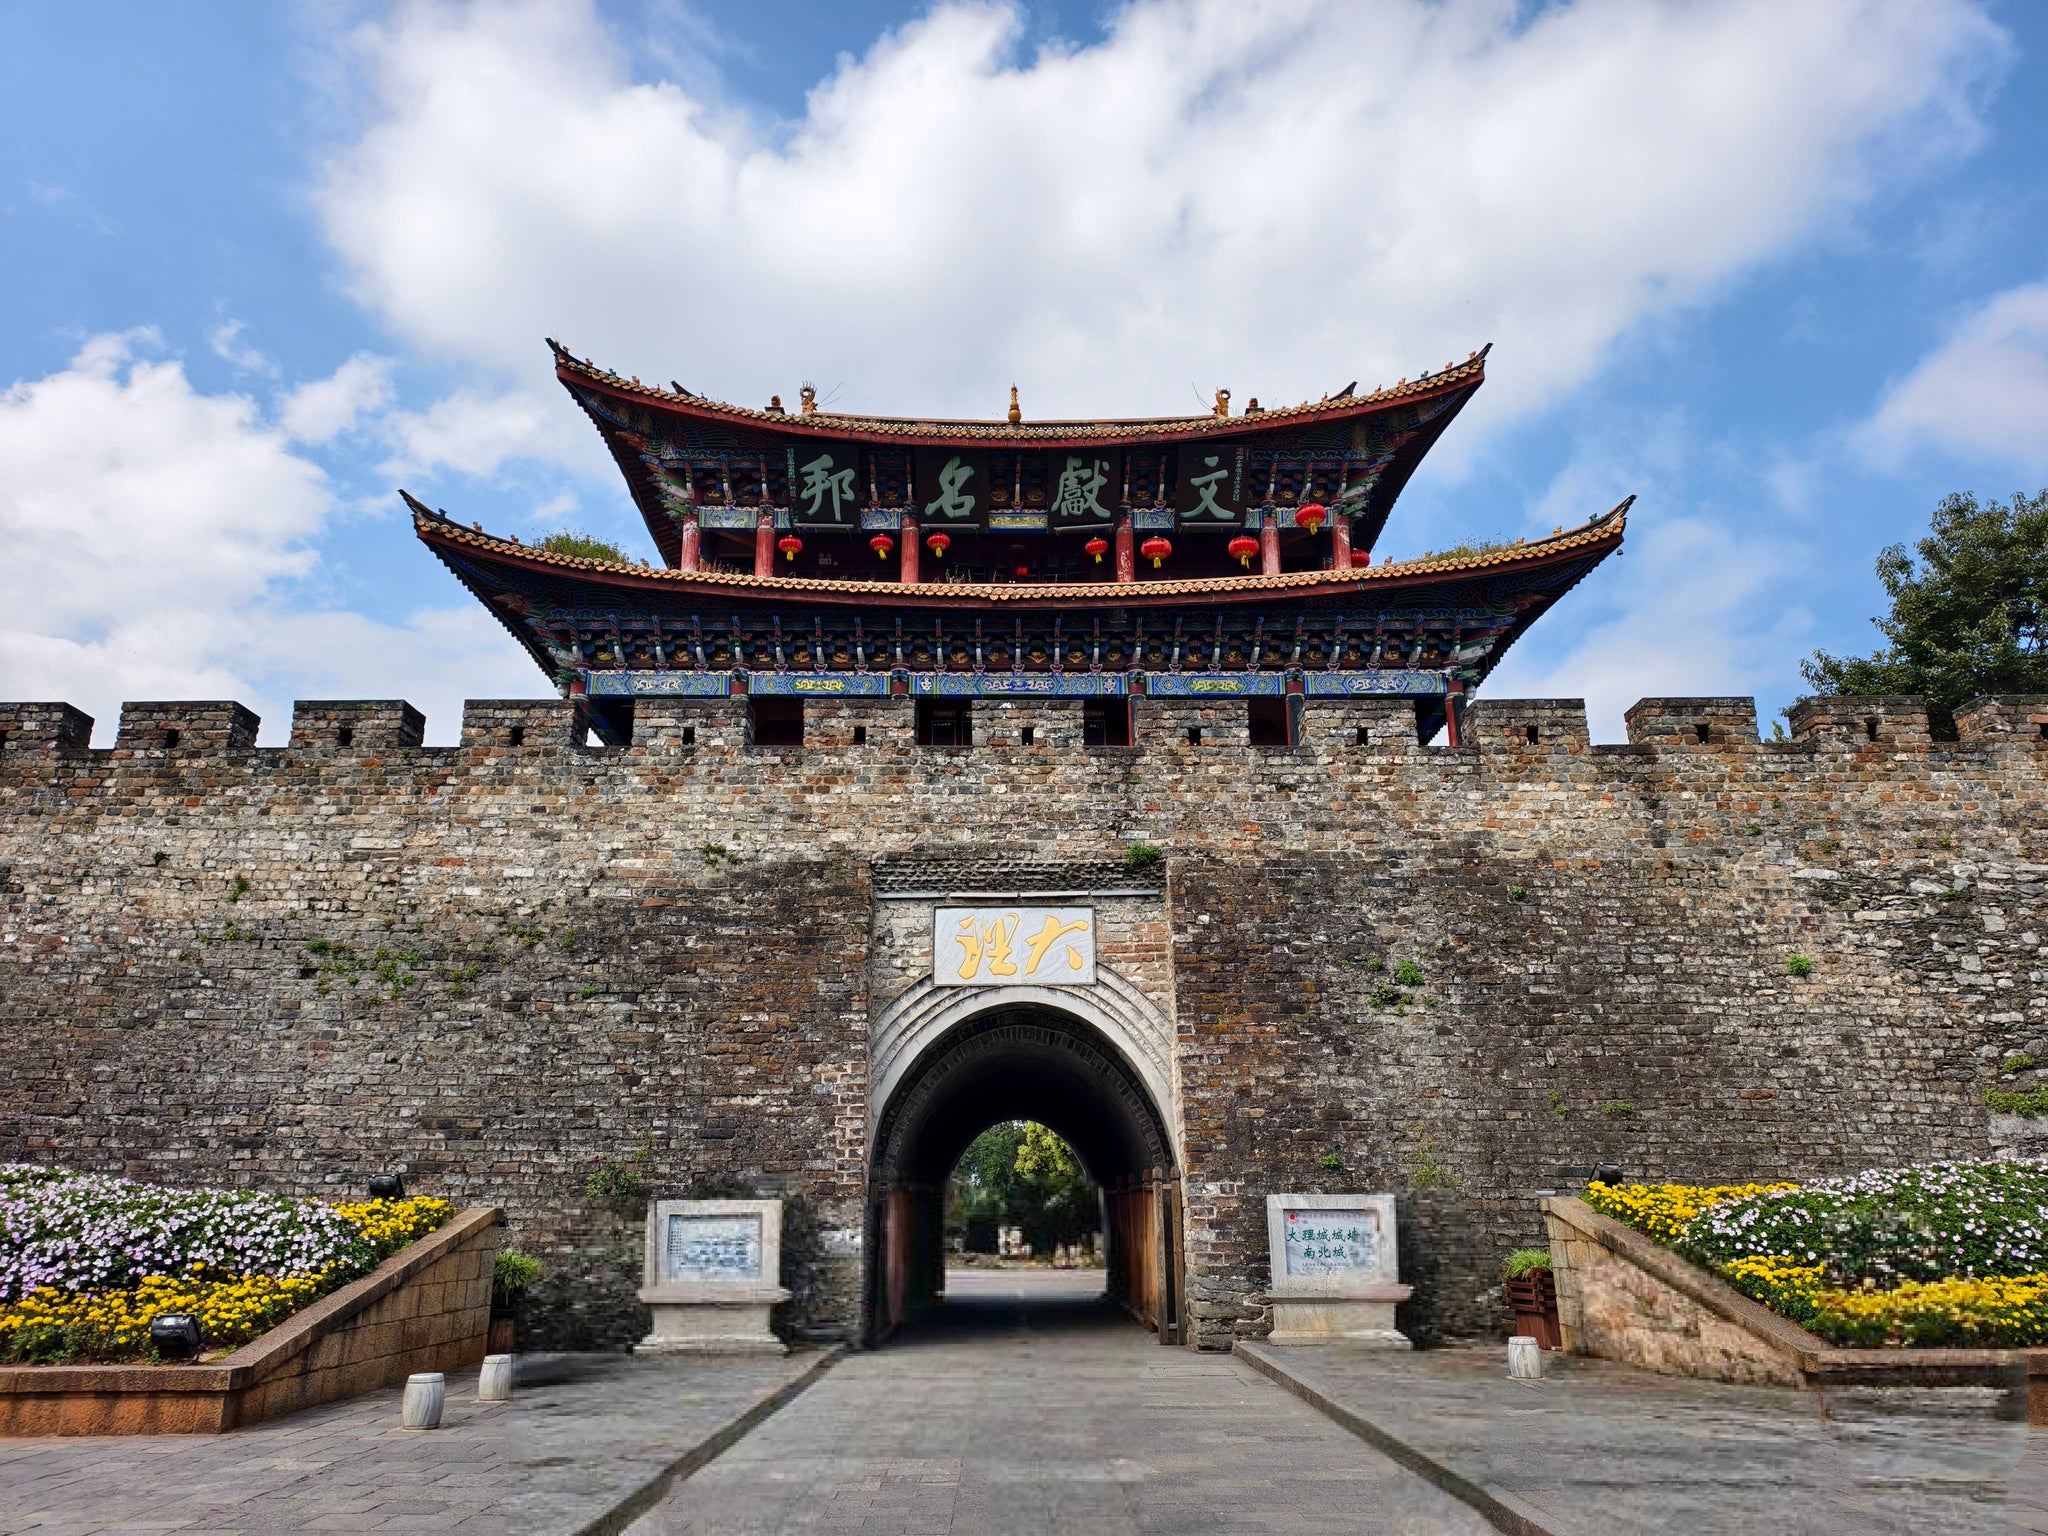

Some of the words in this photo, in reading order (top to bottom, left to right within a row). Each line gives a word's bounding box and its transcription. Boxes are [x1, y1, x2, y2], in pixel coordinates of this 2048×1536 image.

[955, 913, 1089, 979] 大理
[1286, 1227, 1372, 1243] 大理城城墙
[1303, 1245, 1368, 1260] 南北城
